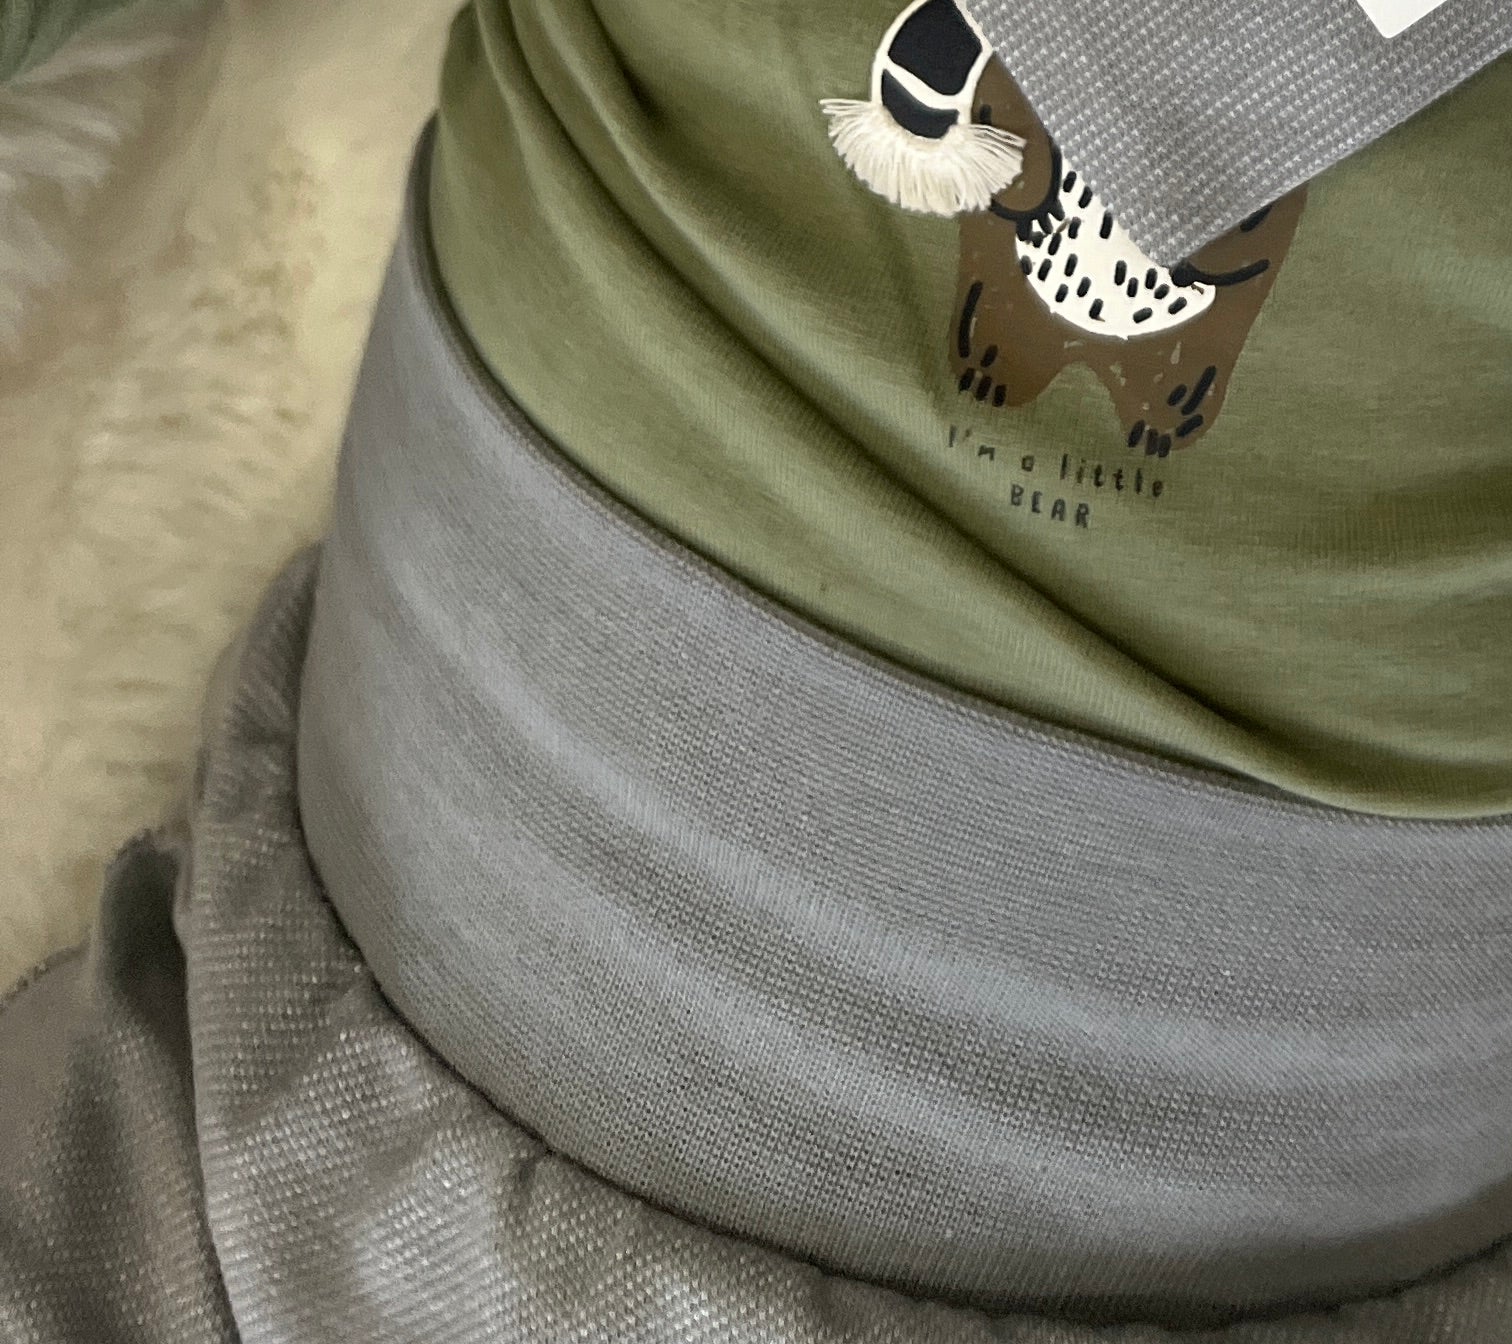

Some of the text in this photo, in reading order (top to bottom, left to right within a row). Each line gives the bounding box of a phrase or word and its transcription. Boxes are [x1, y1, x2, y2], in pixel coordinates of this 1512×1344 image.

[1020, 454, 1036, 473] a
[1059, 453, 1164, 498] little
[1010, 483, 1090, 528] BEAR
